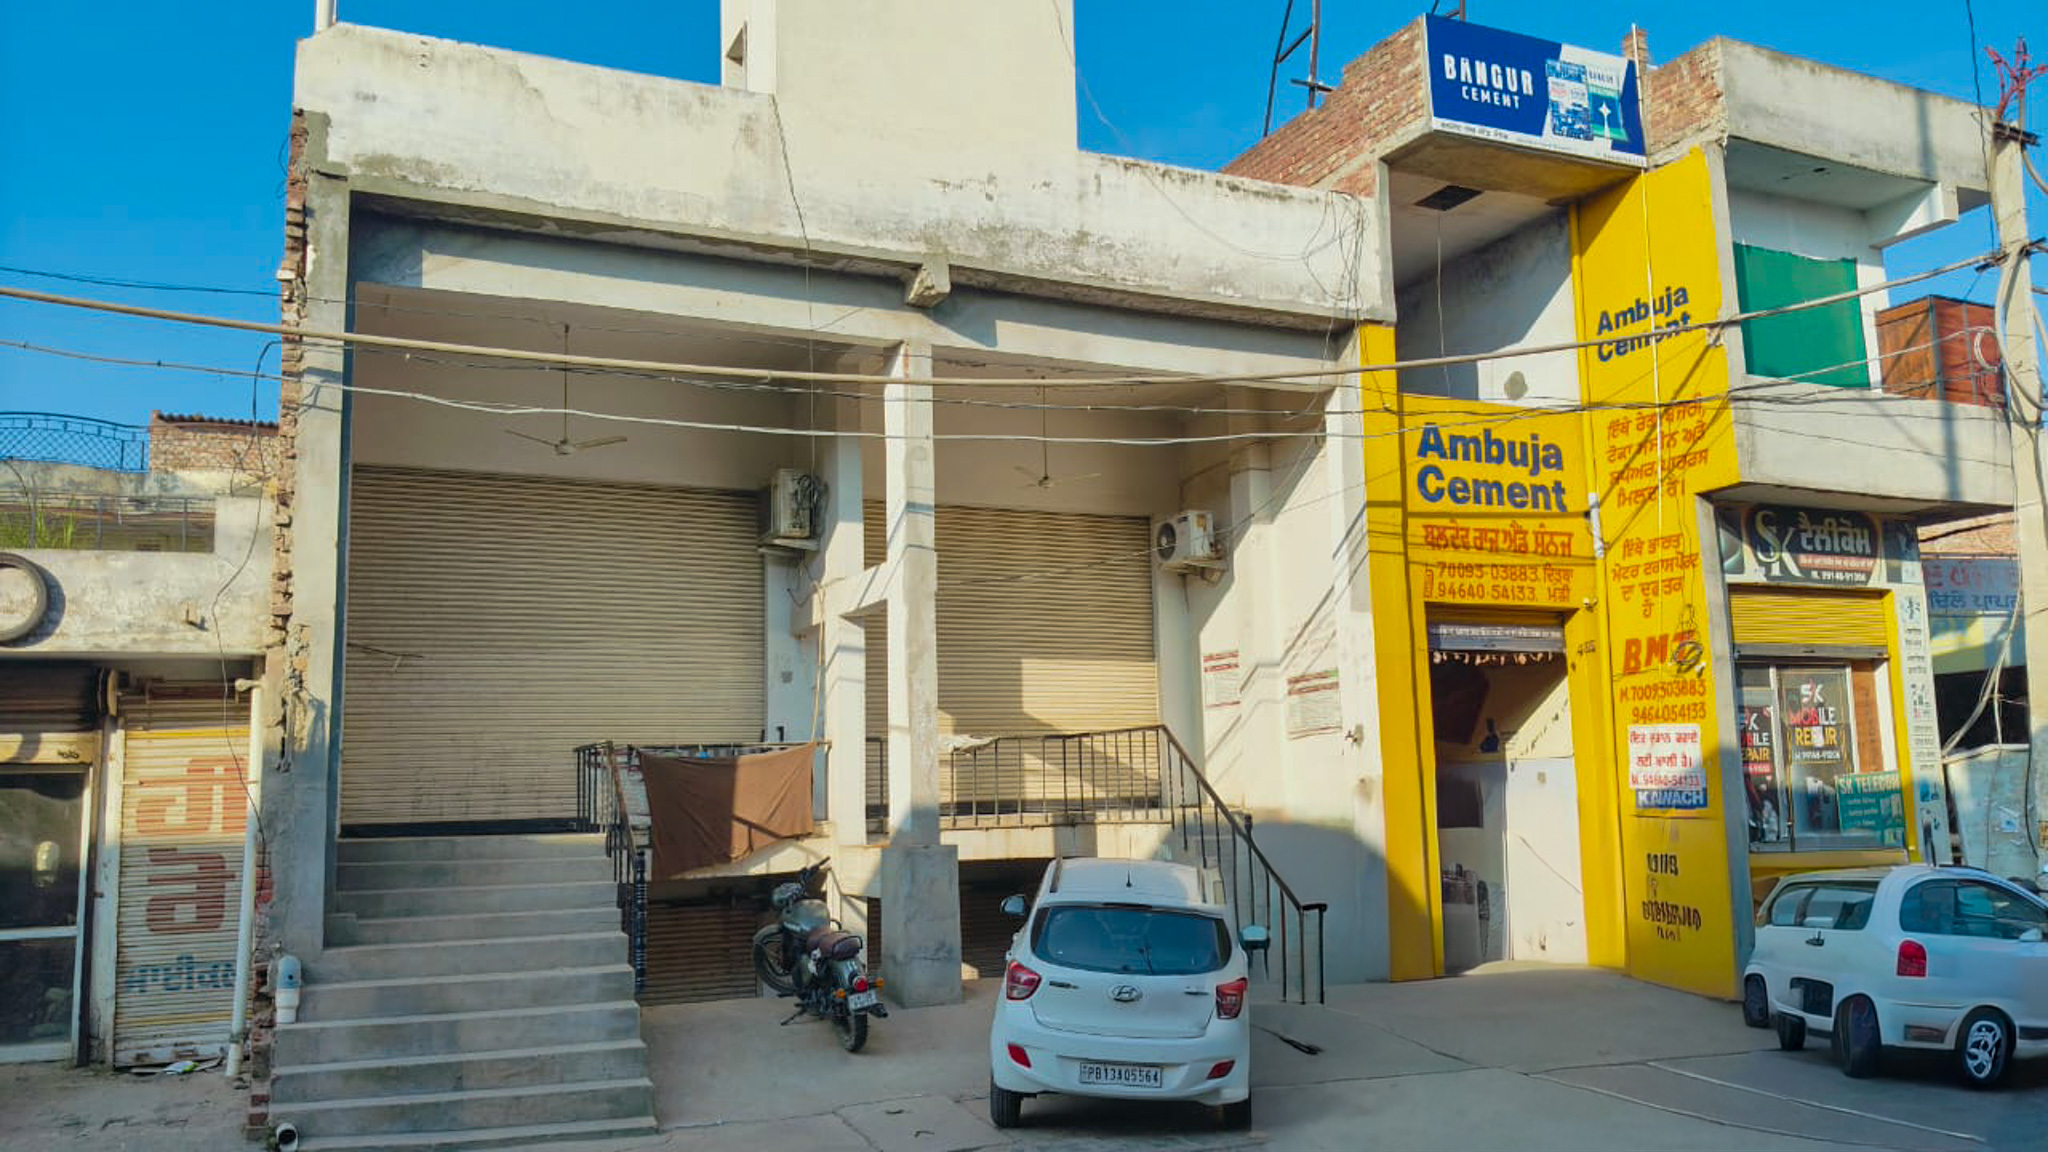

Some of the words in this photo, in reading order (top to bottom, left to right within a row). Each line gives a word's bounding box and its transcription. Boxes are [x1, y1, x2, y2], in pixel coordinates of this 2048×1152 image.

[1443, 53, 1533, 96] BANGUR
[1461, 85, 1520, 110] CEMENT
[1597, 286, 1690, 335] Ambuja
[1597, 311, 1691, 362] Cement
[1417, 422, 1564, 477] Ambuja
[1417, 463, 1568, 512] Cement
[1637, 790, 1704, 806] KAWACH
